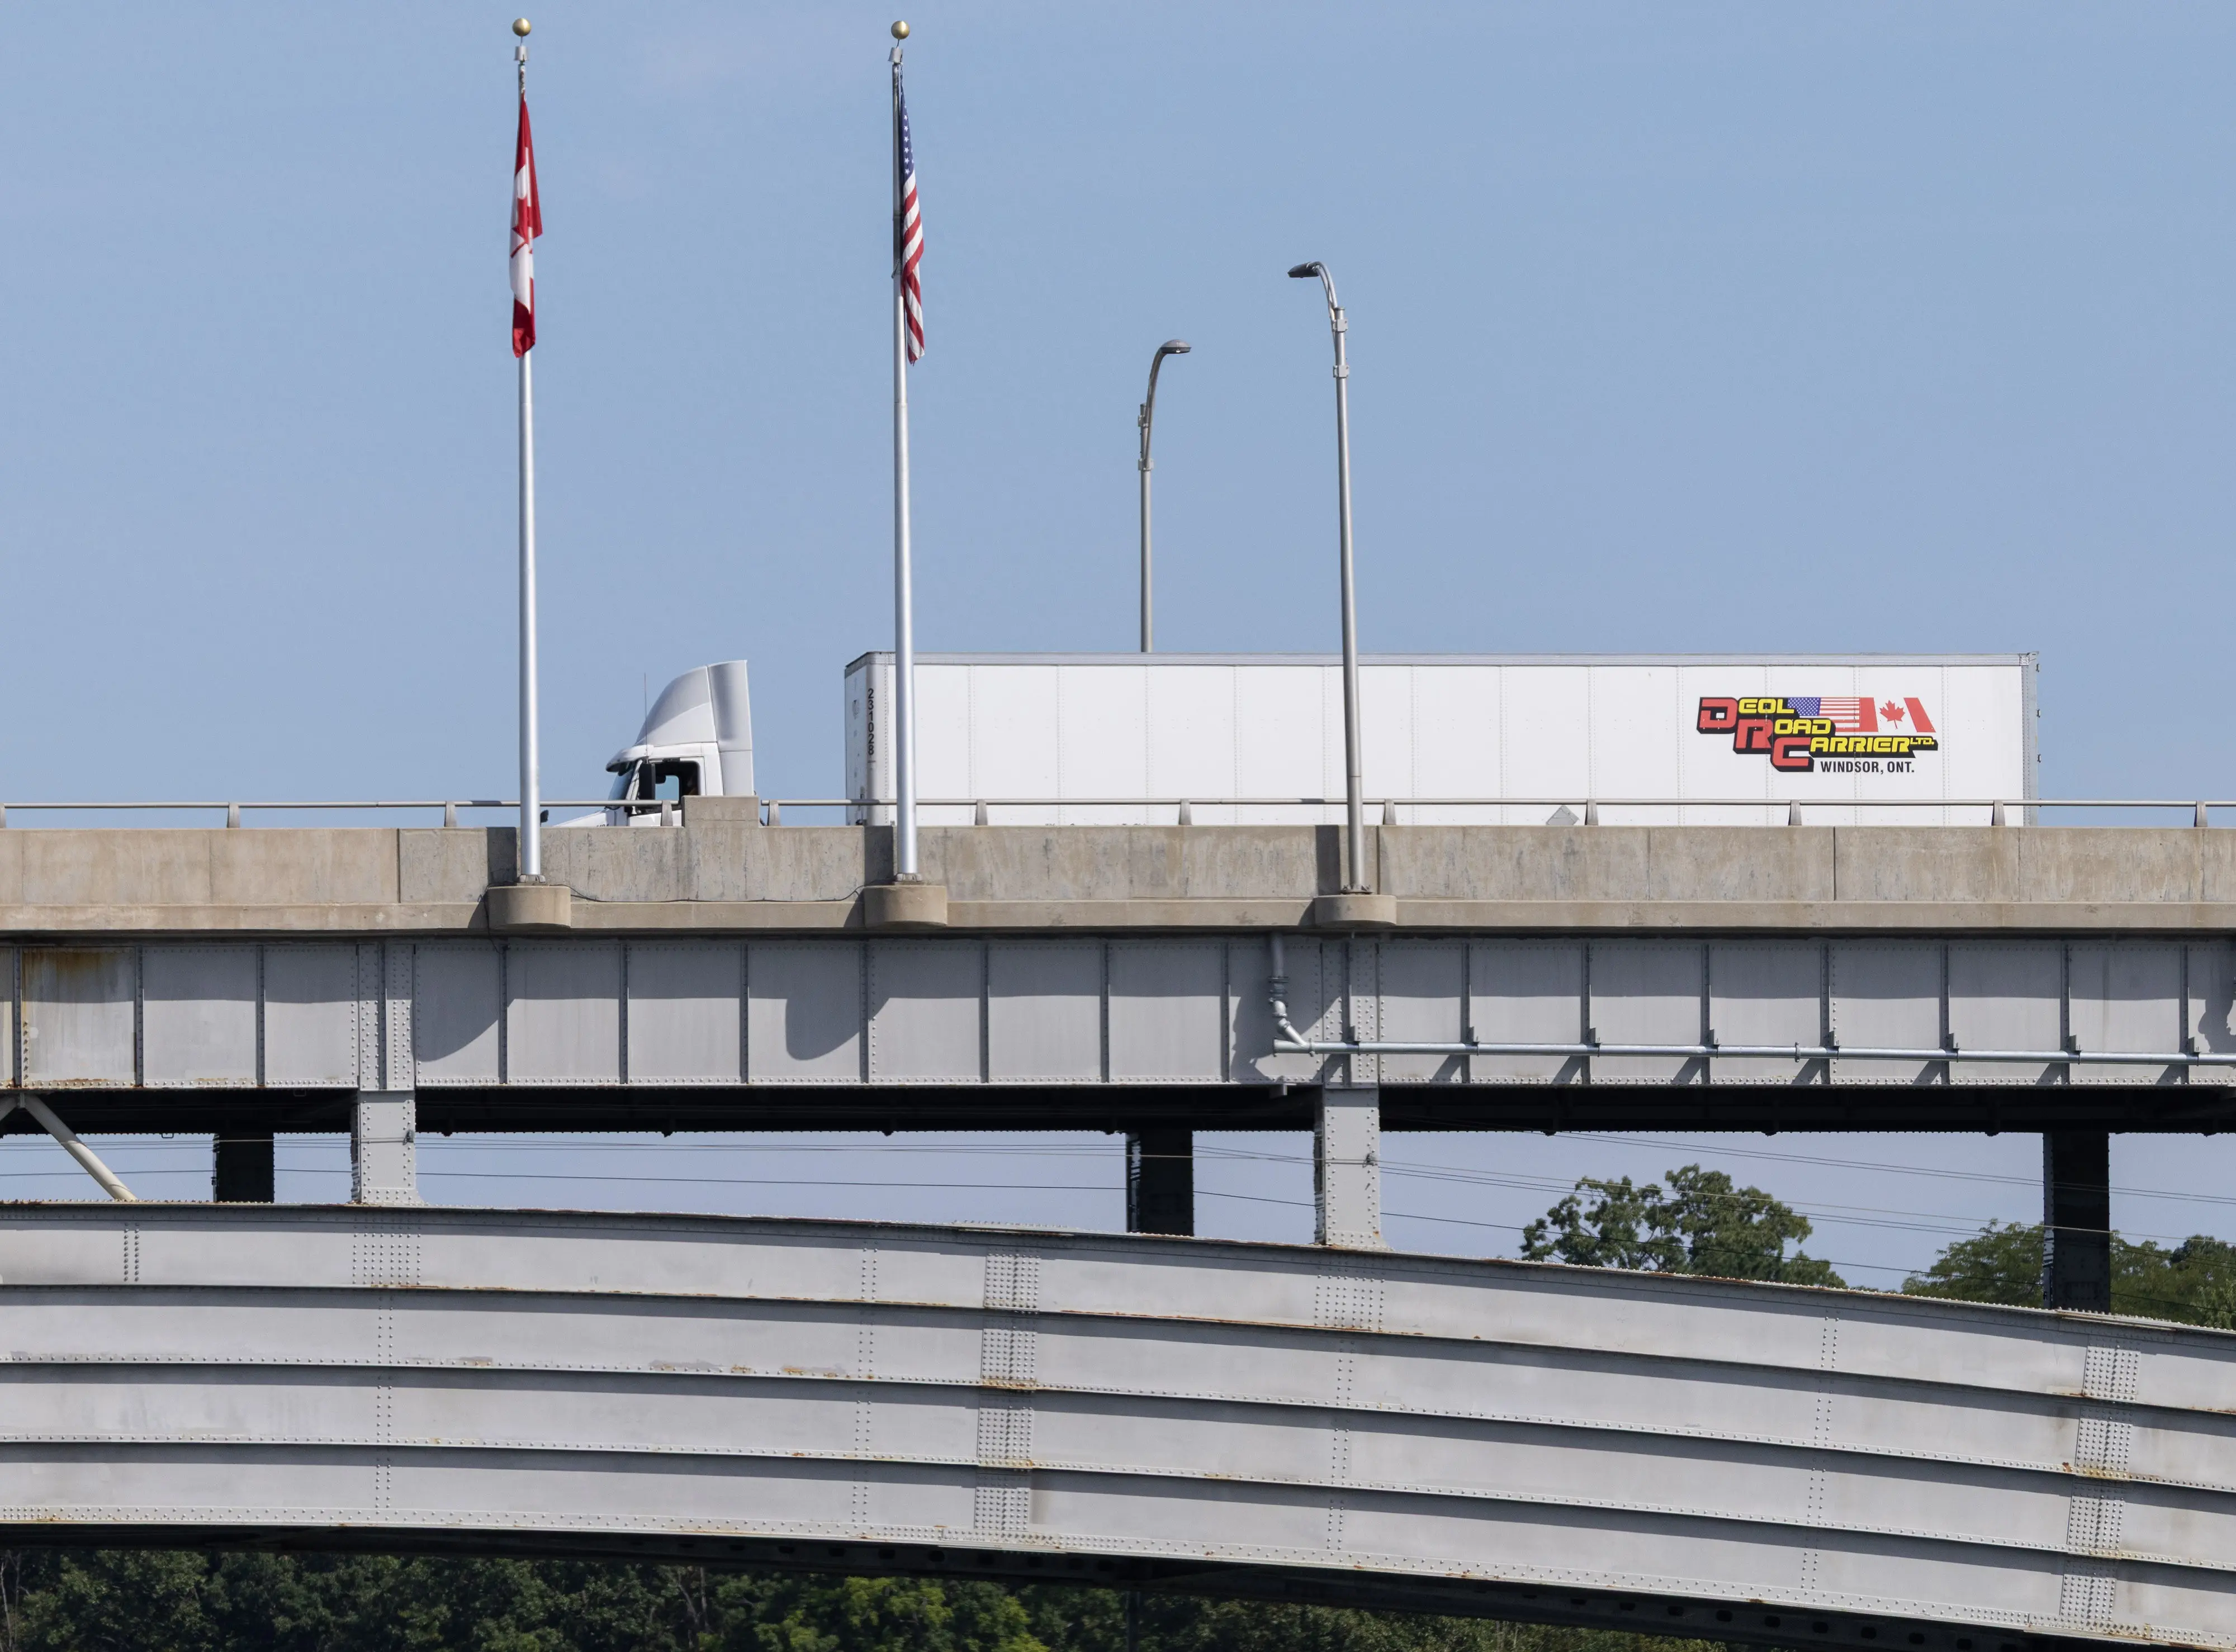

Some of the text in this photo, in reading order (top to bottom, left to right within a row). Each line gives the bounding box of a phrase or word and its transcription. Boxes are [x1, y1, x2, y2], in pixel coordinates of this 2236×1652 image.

[1698, 698, 1796, 729] DEOL
[1735, 719, 1831, 749] ROAD
[1772, 736, 1935, 767] CARRIER LTD.
[1820, 761, 1915, 775] WINDSOR, ONT.
